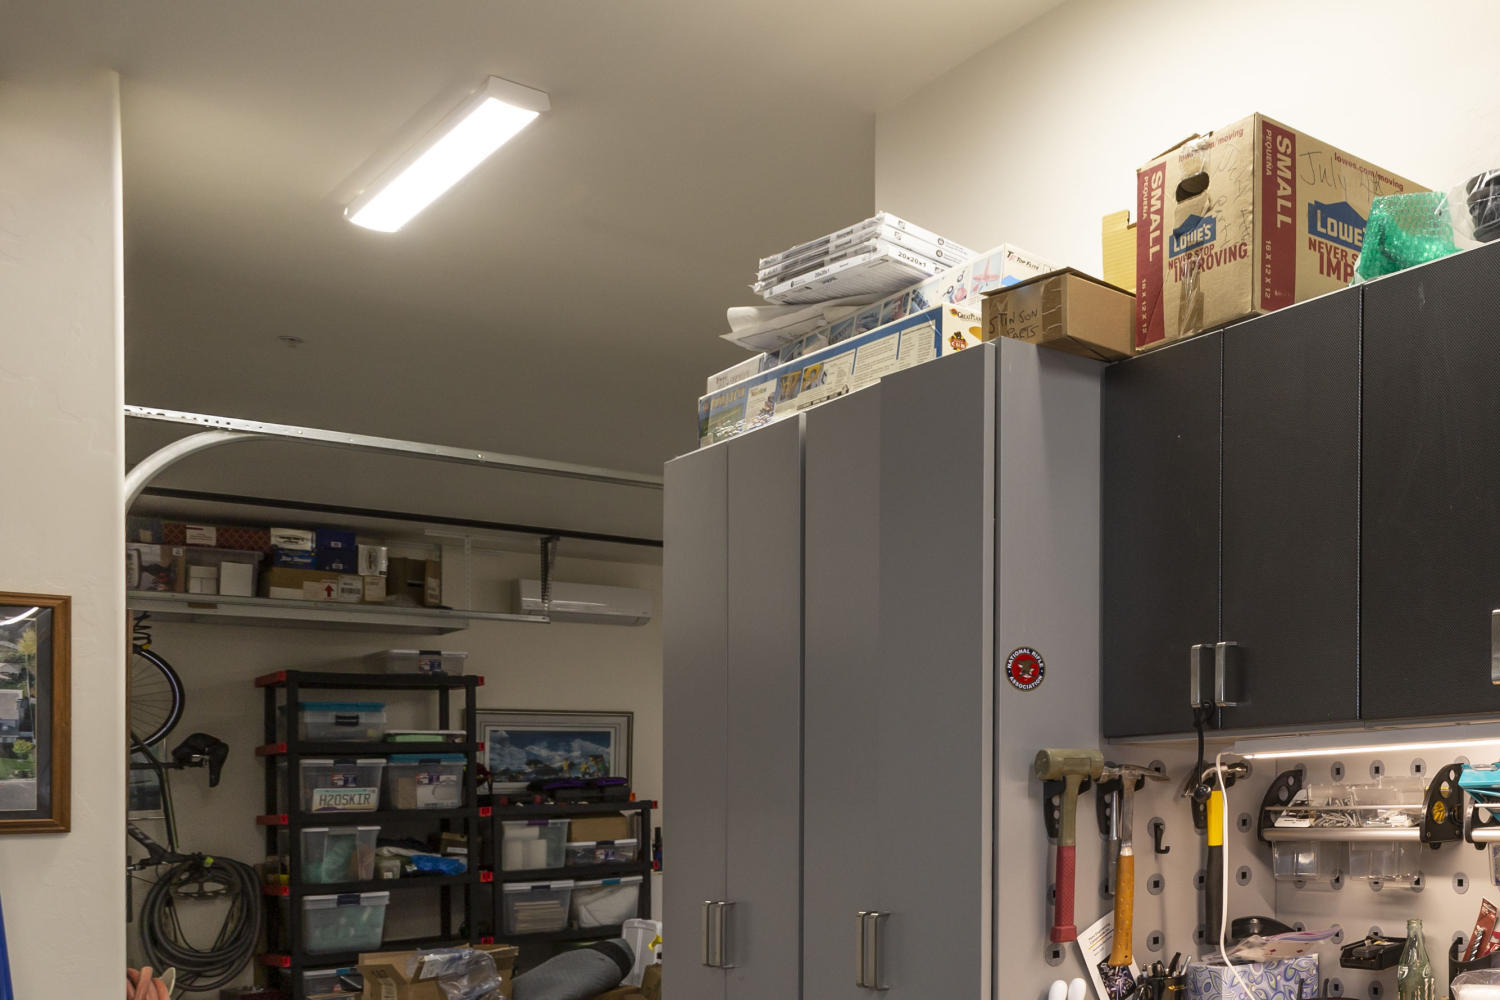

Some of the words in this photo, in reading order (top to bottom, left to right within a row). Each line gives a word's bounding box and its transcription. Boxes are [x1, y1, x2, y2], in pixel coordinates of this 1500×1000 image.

[1276, 134, 1292, 229] SMALL
[1299, 151, 1347, 201] July
[1149, 170, 1163, 262] SMALL
[1316, 209, 1367, 247] LOWE'
[1194, 243, 1215, 258] STOP
[1308, 237, 1350, 261] NEVER
[1265, 264, 1271, 276] 12
[1265, 287, 1271, 299] 12
[1007, 648, 1031, 669] NATIONAL
[1031, 650, 1044, 668] RIFLE
[1009, 676, 1043, 690] ASSOCIATION
